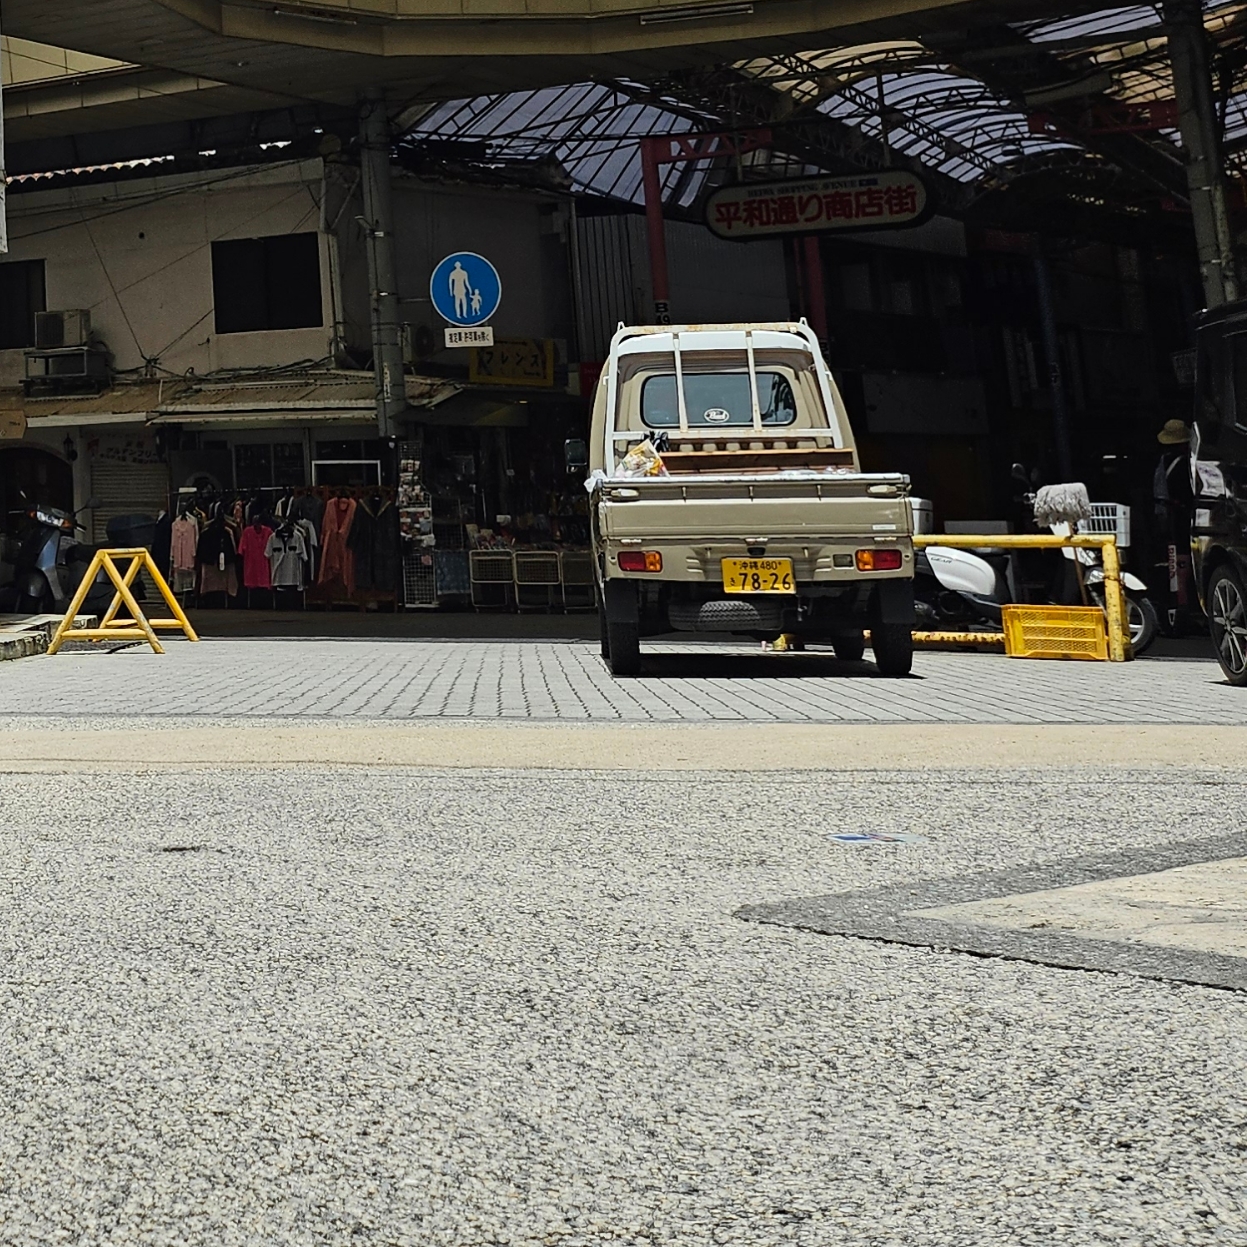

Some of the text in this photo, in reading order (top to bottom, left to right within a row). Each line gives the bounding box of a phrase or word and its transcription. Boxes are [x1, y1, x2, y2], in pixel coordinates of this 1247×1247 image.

[777, 183, 818, 194] SHOPPING
[822, 180, 857, 190] AVENUE
[715, 185, 917, 229] 平和通り商店街
[655, 303, 668, 313] B
[739, 573, 791, 590] 78-26
